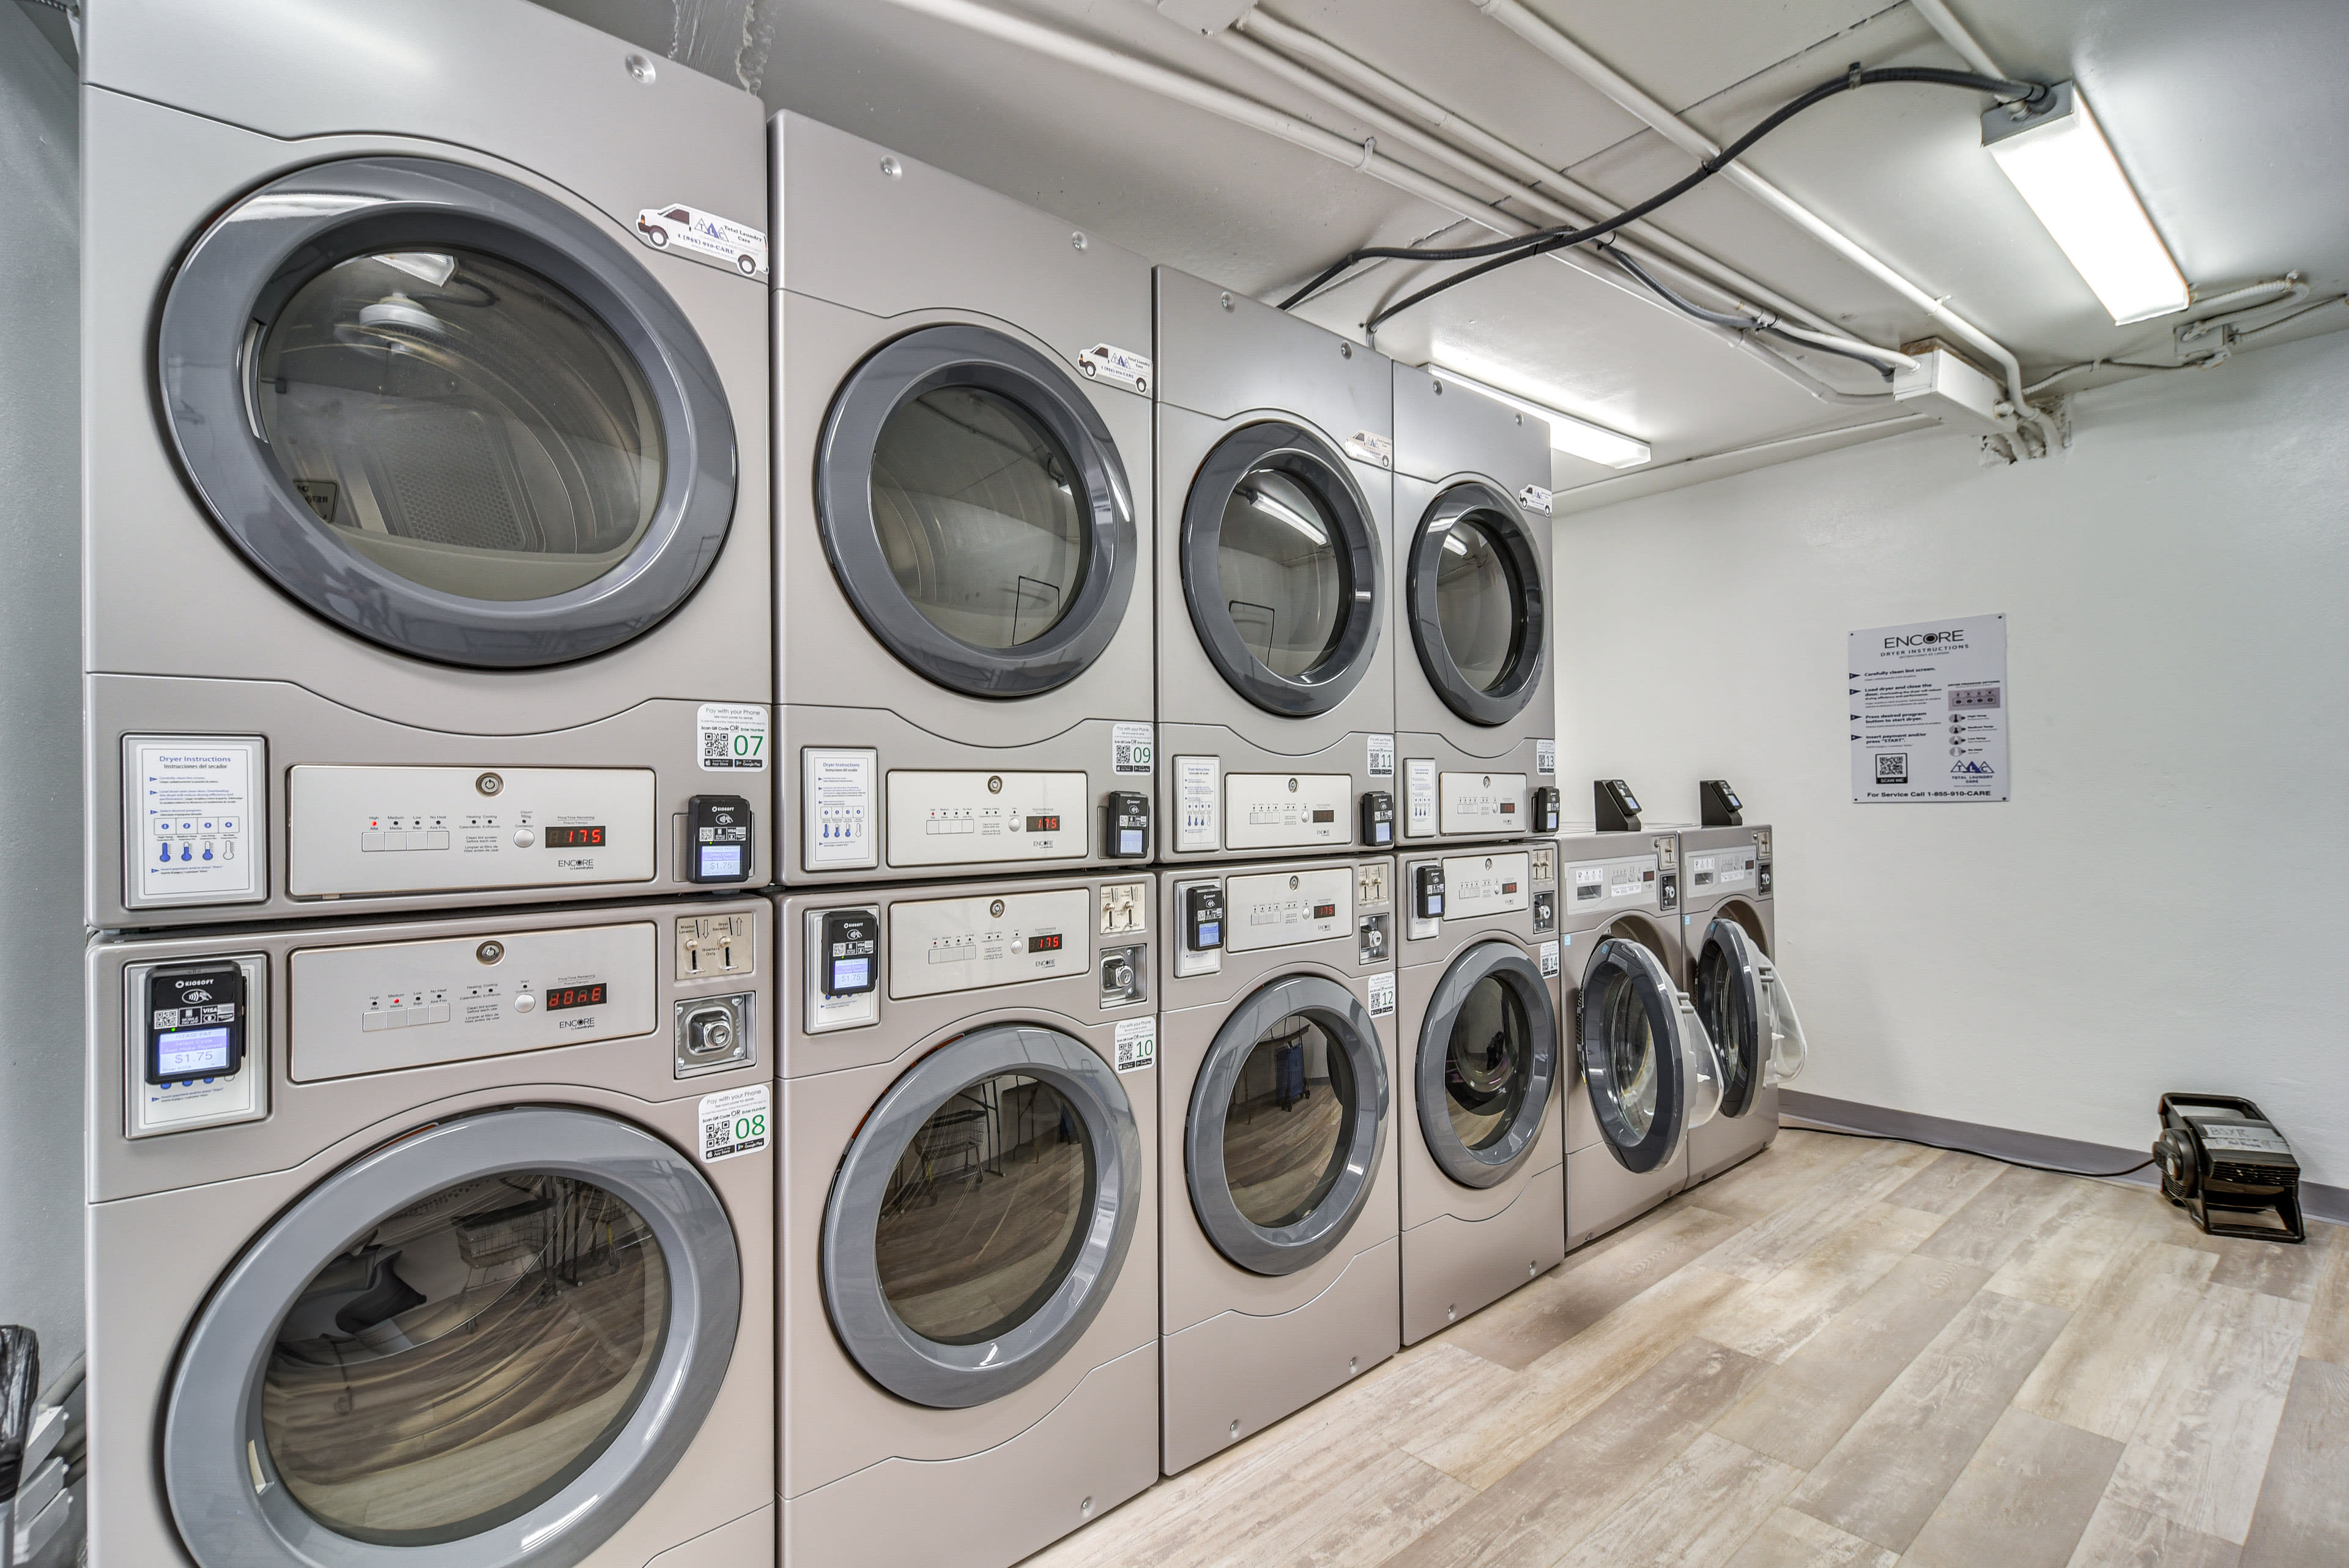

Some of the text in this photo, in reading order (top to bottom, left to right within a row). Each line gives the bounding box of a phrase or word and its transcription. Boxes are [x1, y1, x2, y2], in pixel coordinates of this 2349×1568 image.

[740, 230, 763, 242] Laundry
[683, 235, 701, 245] (855)
[702, 242, 735, 255] 910-CARE
[1884, 630, 1964, 649] ENCORE
[1908, 644, 1970, 654] INSTRUCTIONS
[734, 735, 763, 756] 07
[1134, 746, 1151, 764] 09
[1381, 754, 1392, 768] 11
[1546, 755, 1554, 767] 13
[1038, 817, 1057, 829] 175
[569, 829, 601, 843] 175
[558, 858, 594, 868] ENCORE
[710, 861, 732, 870] $1.75
[1319, 905, 1333, 915] 175
[1039, 936, 1059, 948] 175
[1035, 959, 1055, 967] ENCORE
[1549, 958, 1558, 969] 14
[841, 974, 861, 983] $1.75
[1382, 990, 1393, 1006] 12
[559, 1017, 595, 1029] ENCORE
[1137, 1039, 1153, 1058] 10
[175, 1052, 213, 1064] $1.75
[736, 1114, 765, 1139] 08
